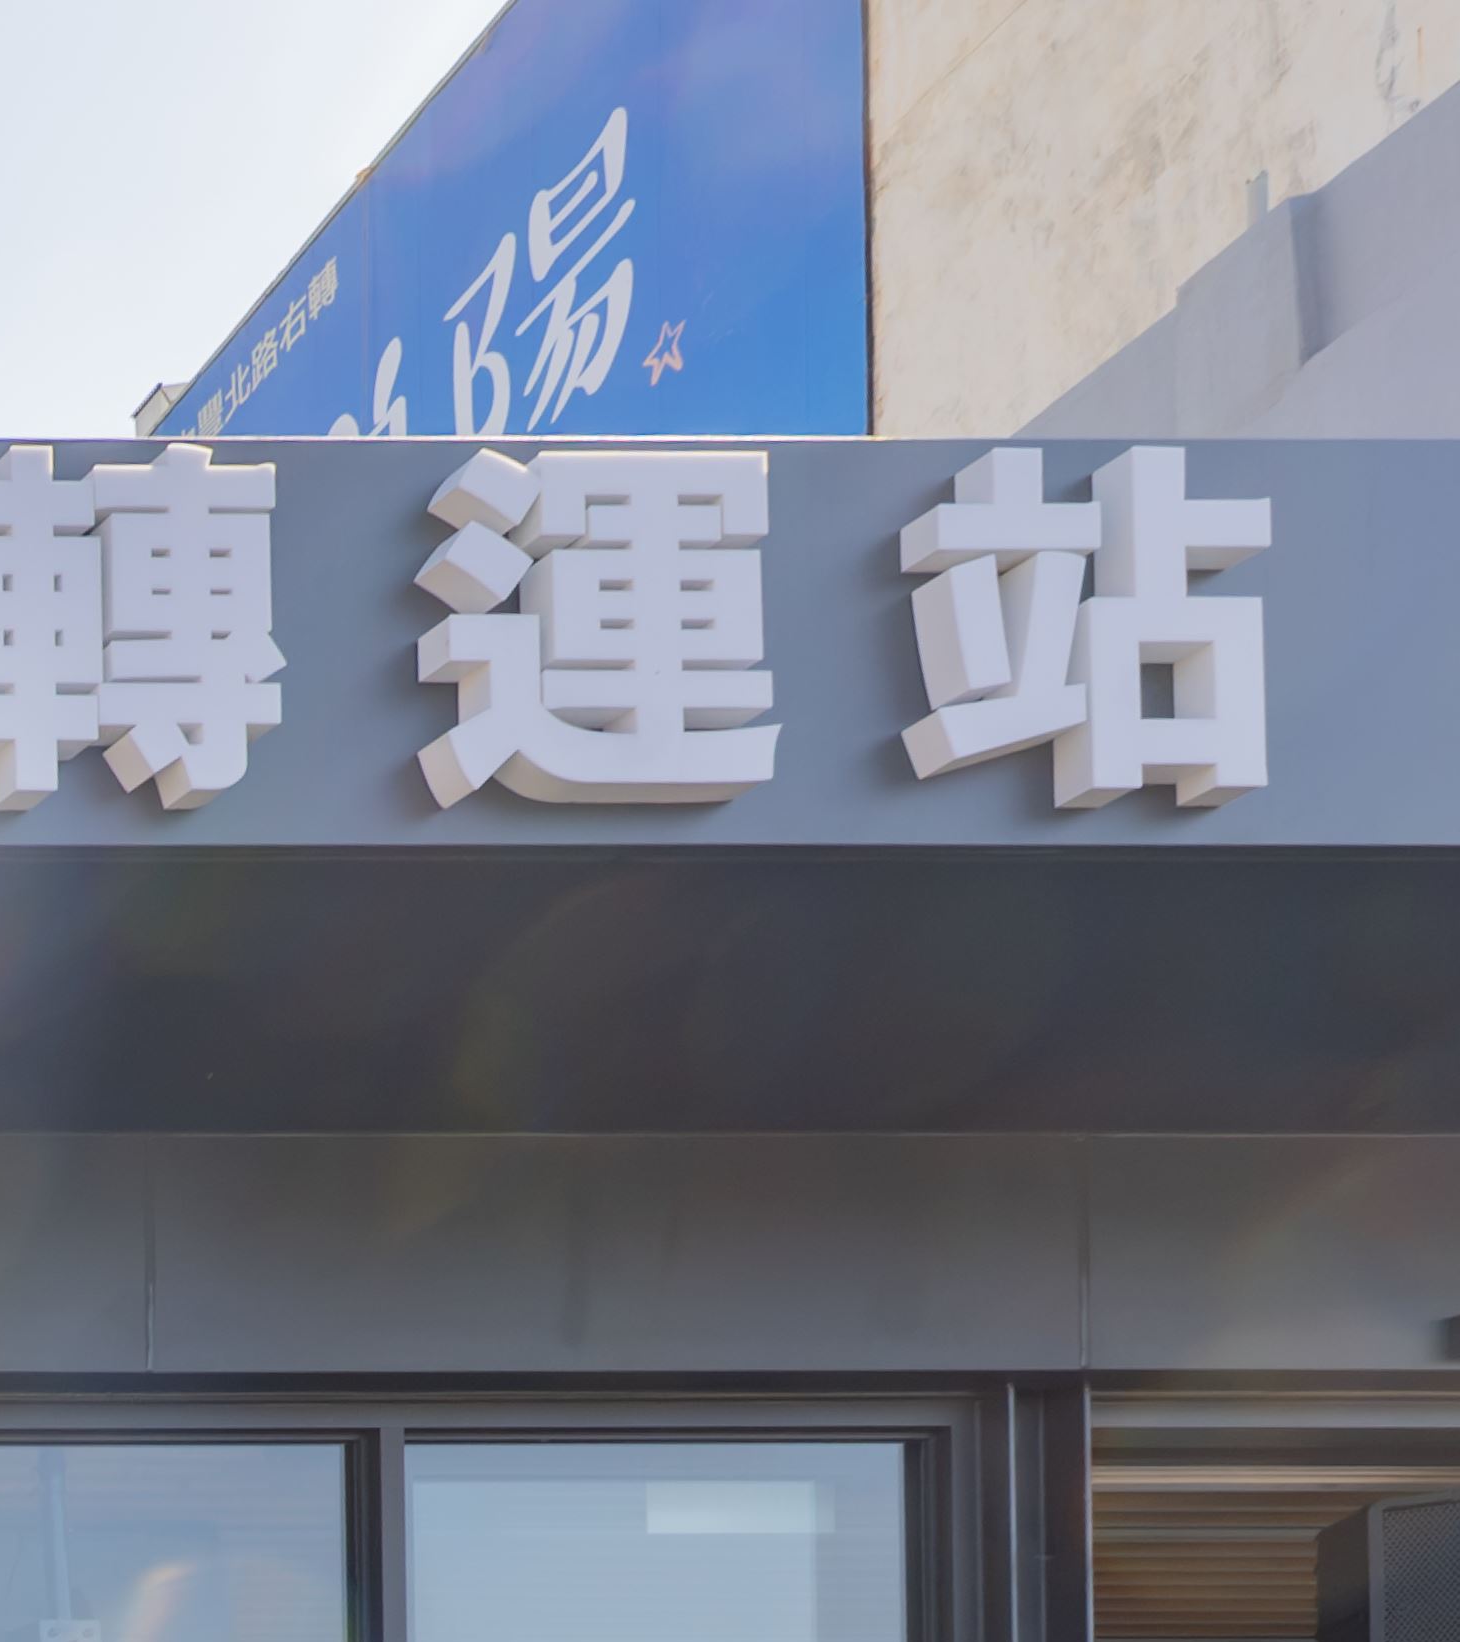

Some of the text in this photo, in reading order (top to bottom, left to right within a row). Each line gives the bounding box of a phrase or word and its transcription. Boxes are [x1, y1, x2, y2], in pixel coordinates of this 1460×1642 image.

[181, 256, 338, 437] 豐北路右轉
